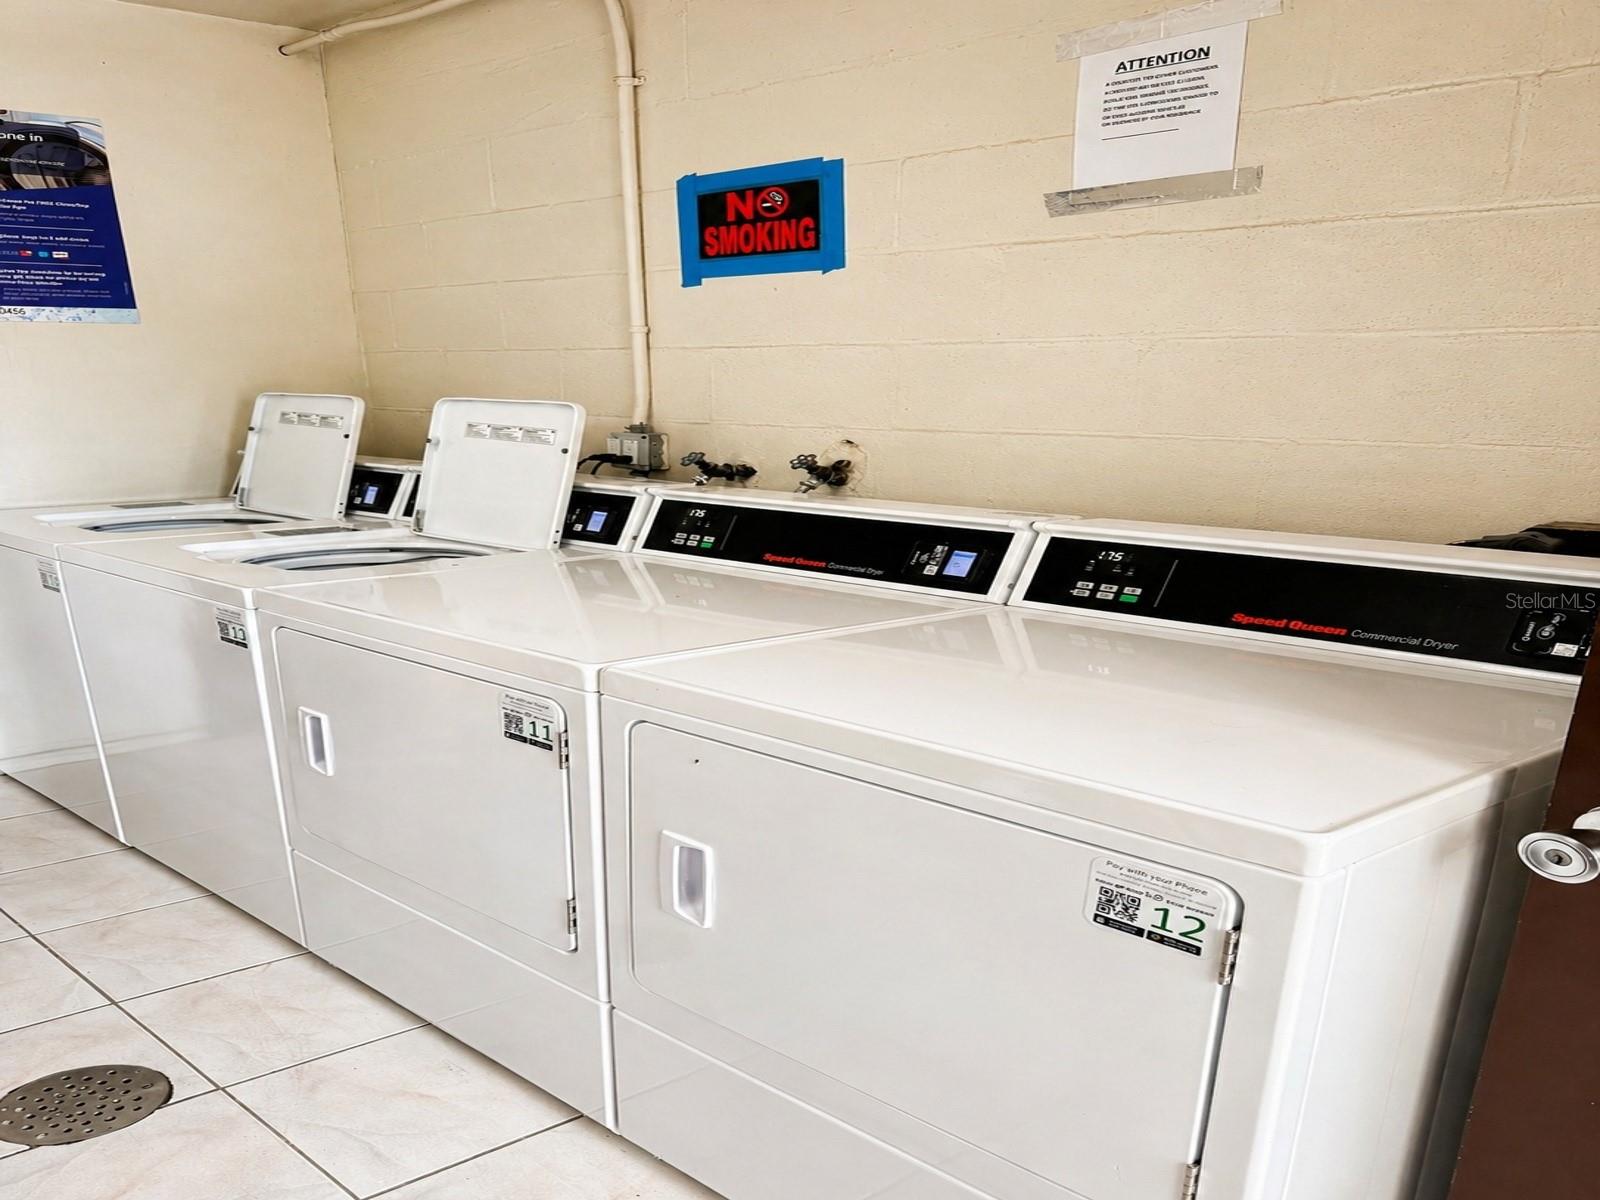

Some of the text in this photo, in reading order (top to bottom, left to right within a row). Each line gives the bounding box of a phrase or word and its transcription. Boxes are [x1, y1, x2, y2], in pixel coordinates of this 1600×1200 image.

[1115, 46, 1211, 73] ATTENTION
[29, 133, 44, 142] in
[704, 217, 816, 257] SMOKING
[763, 553, 795, 564] Speed
[865, 567, 884, 576] Dryer
[1232, 612, 1459, 651] Speed Queen Commercial Dryer
[528, 721, 553, 743] 11
[1150, 907, 1207, 943] 12
